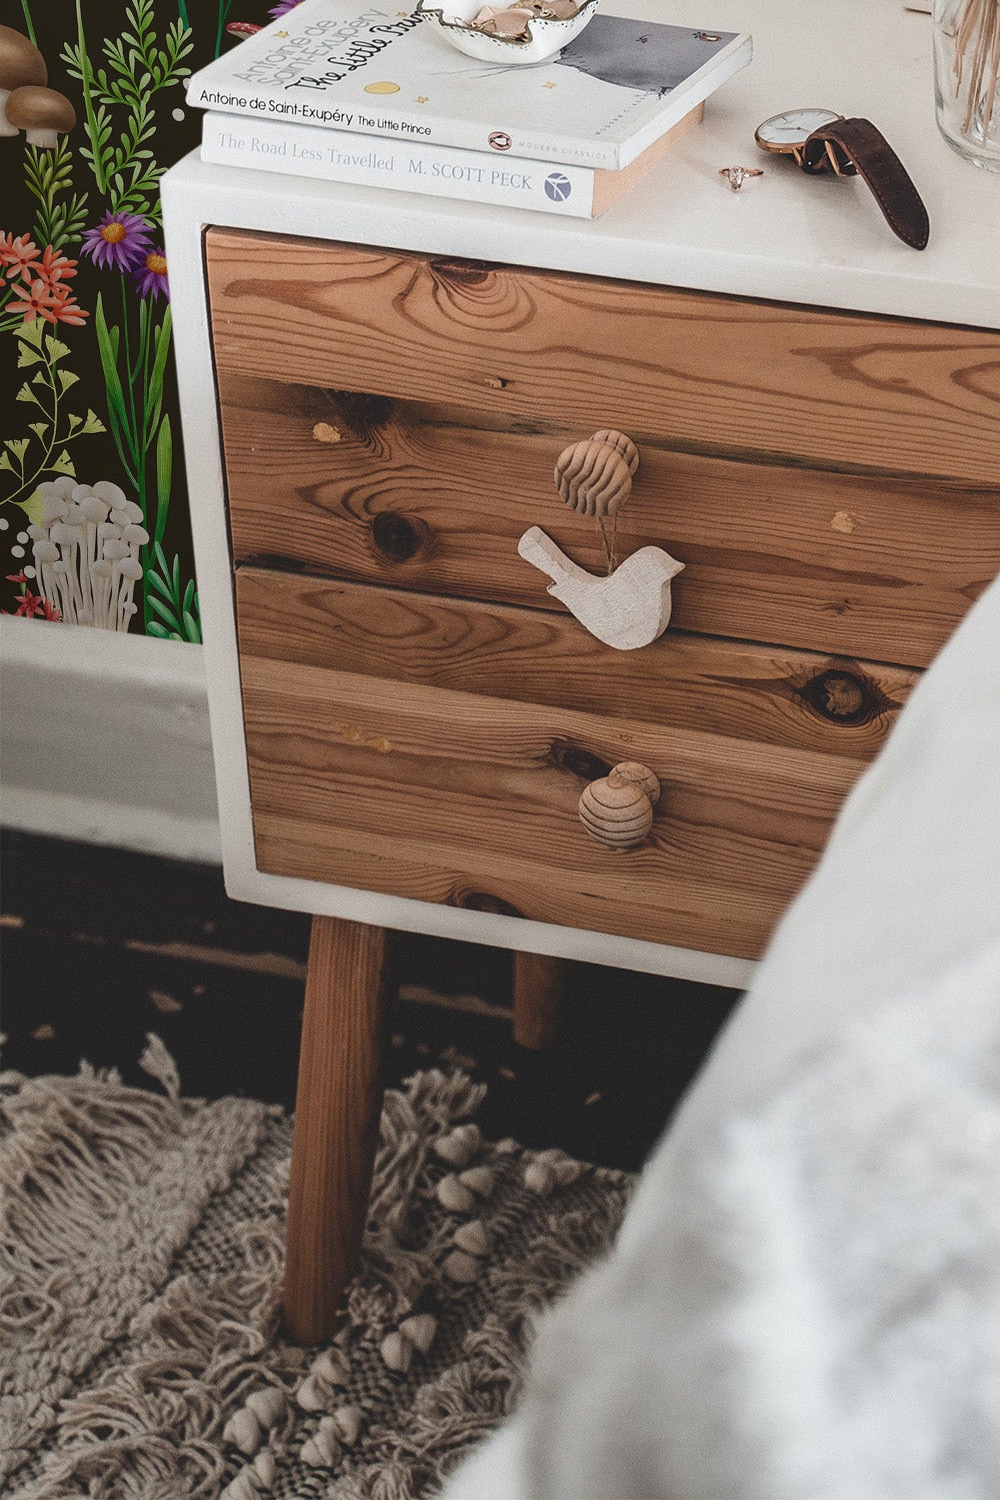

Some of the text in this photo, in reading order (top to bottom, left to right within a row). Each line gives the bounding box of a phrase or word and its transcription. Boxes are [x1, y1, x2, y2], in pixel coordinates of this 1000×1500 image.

[232, 19, 338, 83] Antoine de
[258, 8, 390, 86] Saint-Exupéry
[284, 8, 423, 90] The Little Prin
[200, 89, 432, 136] Antoine de Saint-Exupéry The Little Prince
[218, 132, 533, 190] The Road Less Travelled M. SCOTT PECK
[518, 141, 608, 161] MODERN CLASSICS
